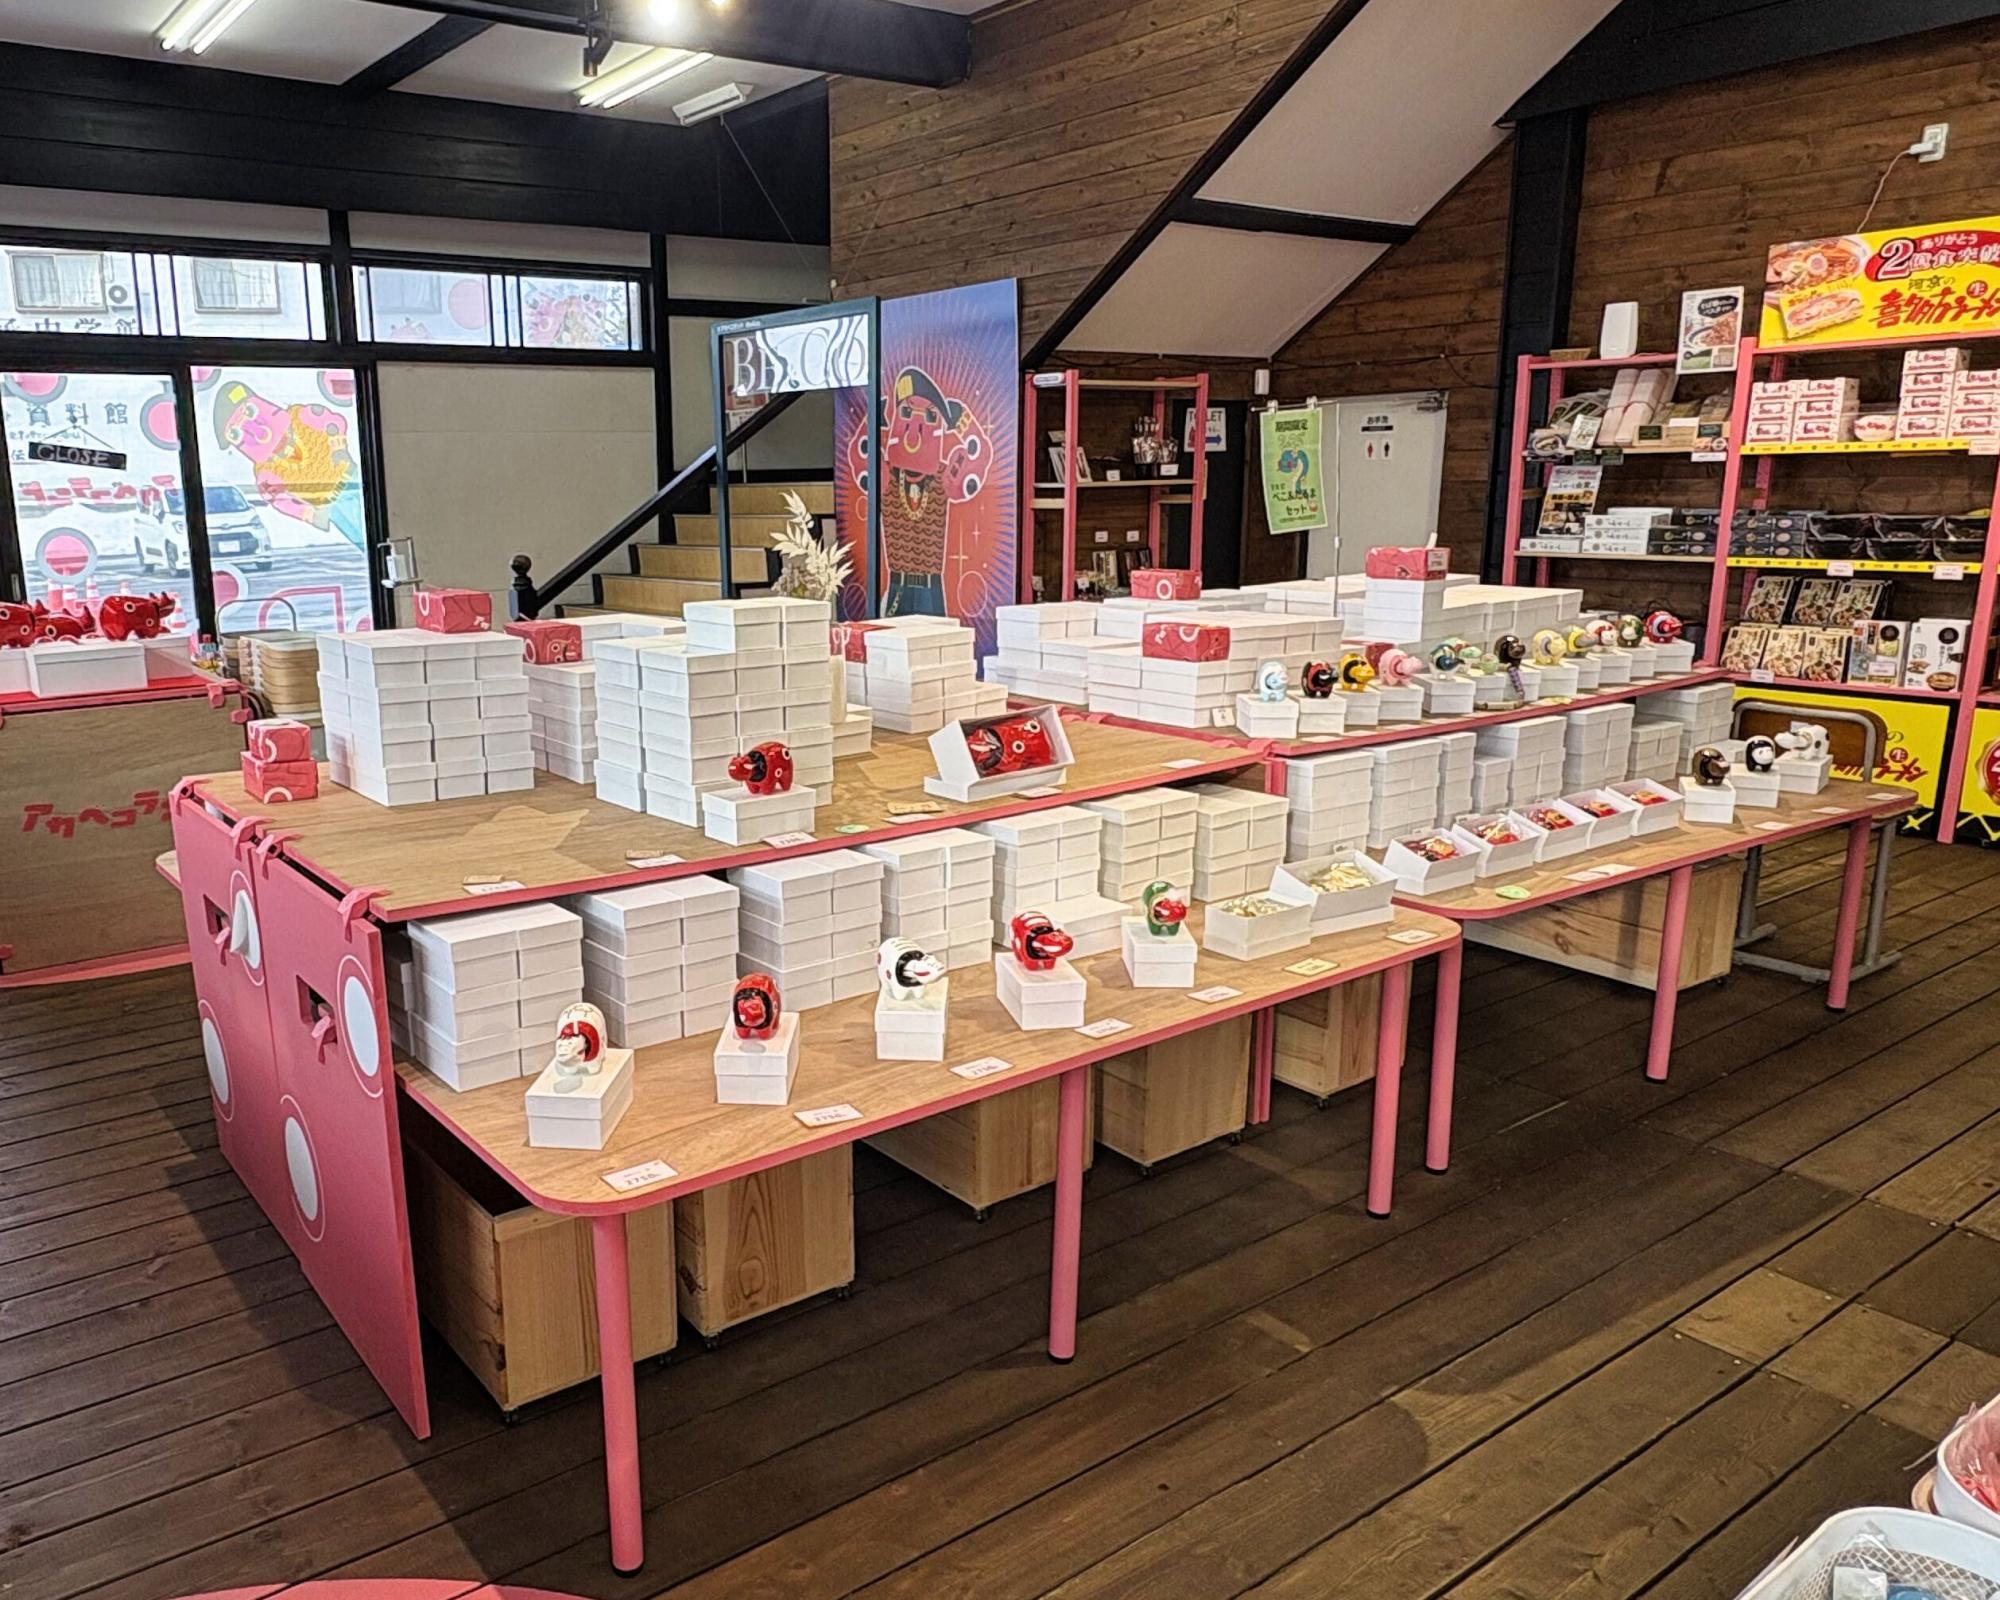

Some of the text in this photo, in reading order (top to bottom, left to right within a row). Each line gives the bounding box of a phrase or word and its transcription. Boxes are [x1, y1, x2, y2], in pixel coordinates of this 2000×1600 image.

[1920, 232, 1979, 250] ありがとう
[1967, 280, 1989, 298] 生
[36, 444, 110, 467] CLOSE
